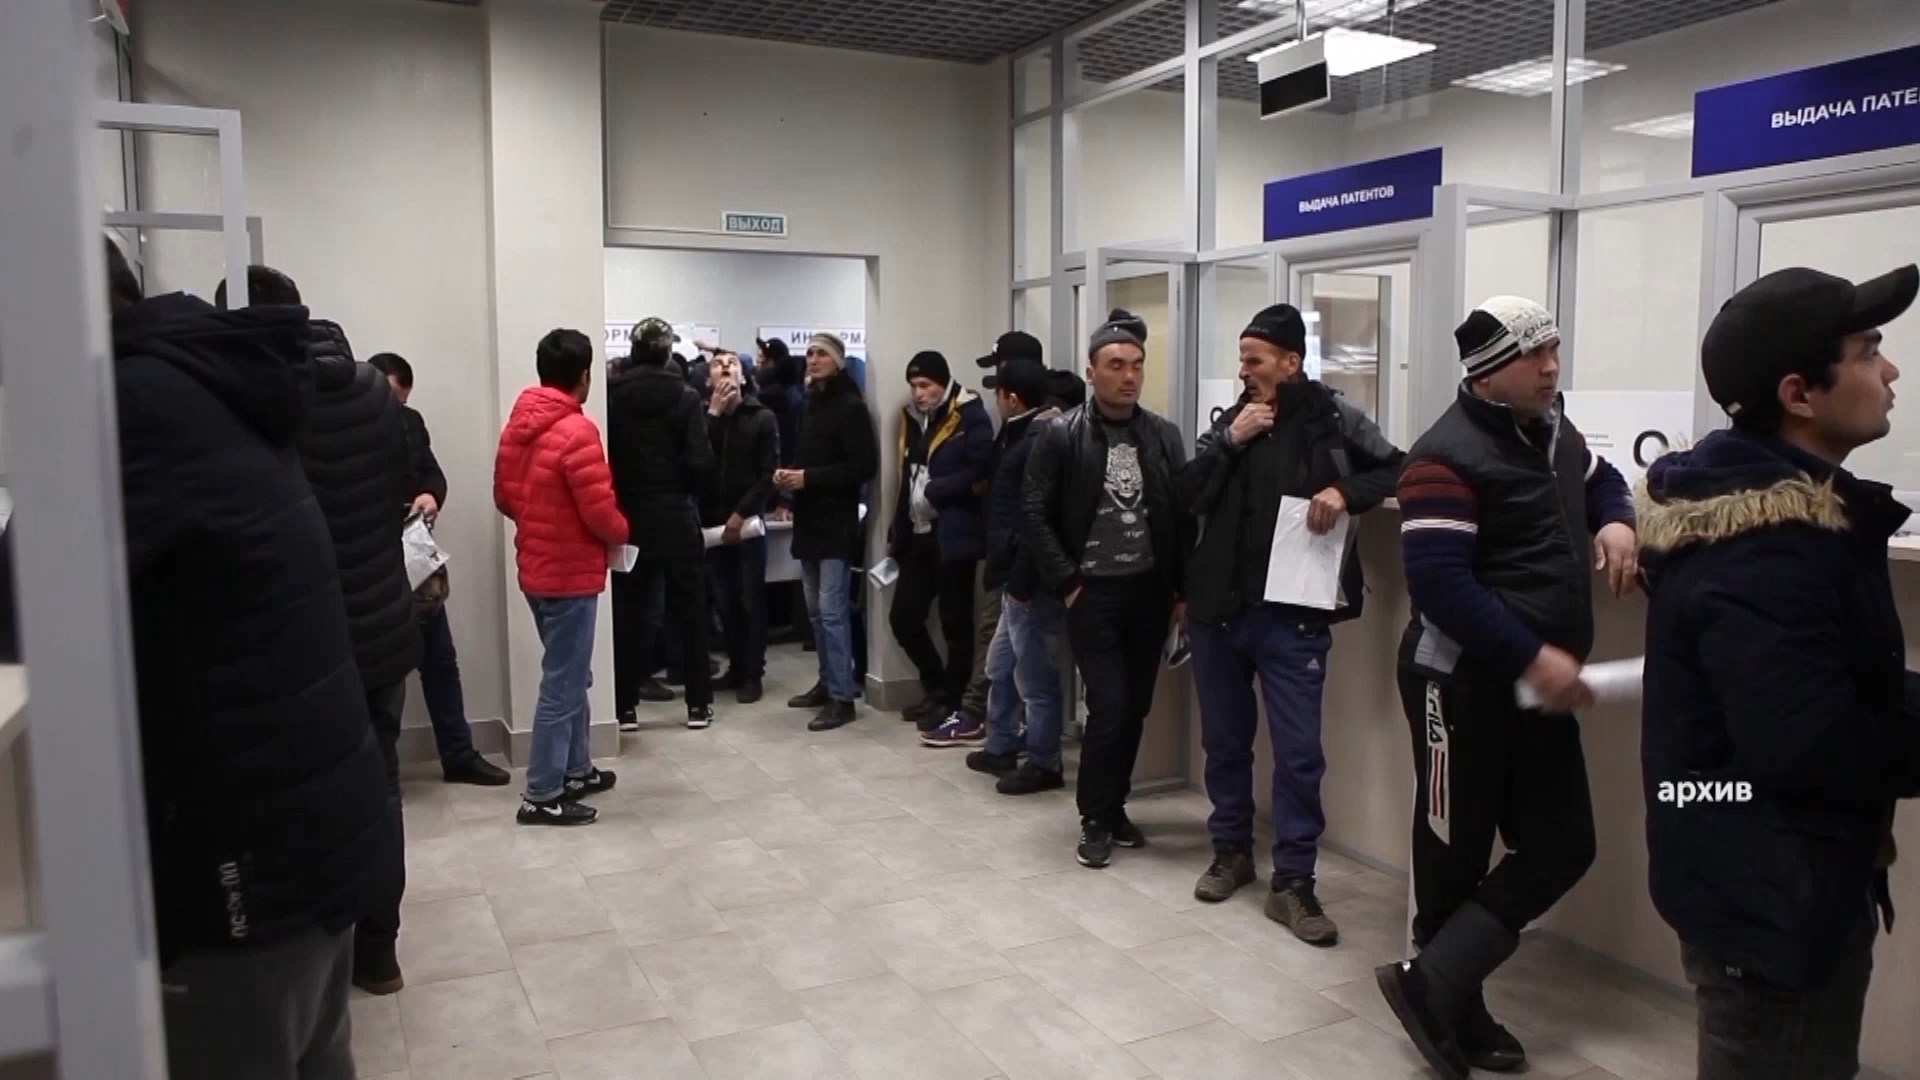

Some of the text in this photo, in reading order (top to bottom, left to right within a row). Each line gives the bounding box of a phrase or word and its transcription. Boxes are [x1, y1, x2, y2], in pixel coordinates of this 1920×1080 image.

[1771, 87, 1920, 128] ВЫДАЧА ПАТЕ
[1298, 184, 1395, 213] ВЫДАЧА ПАТЕНТОВ
[729, 217, 781, 232] ВЫХОД
